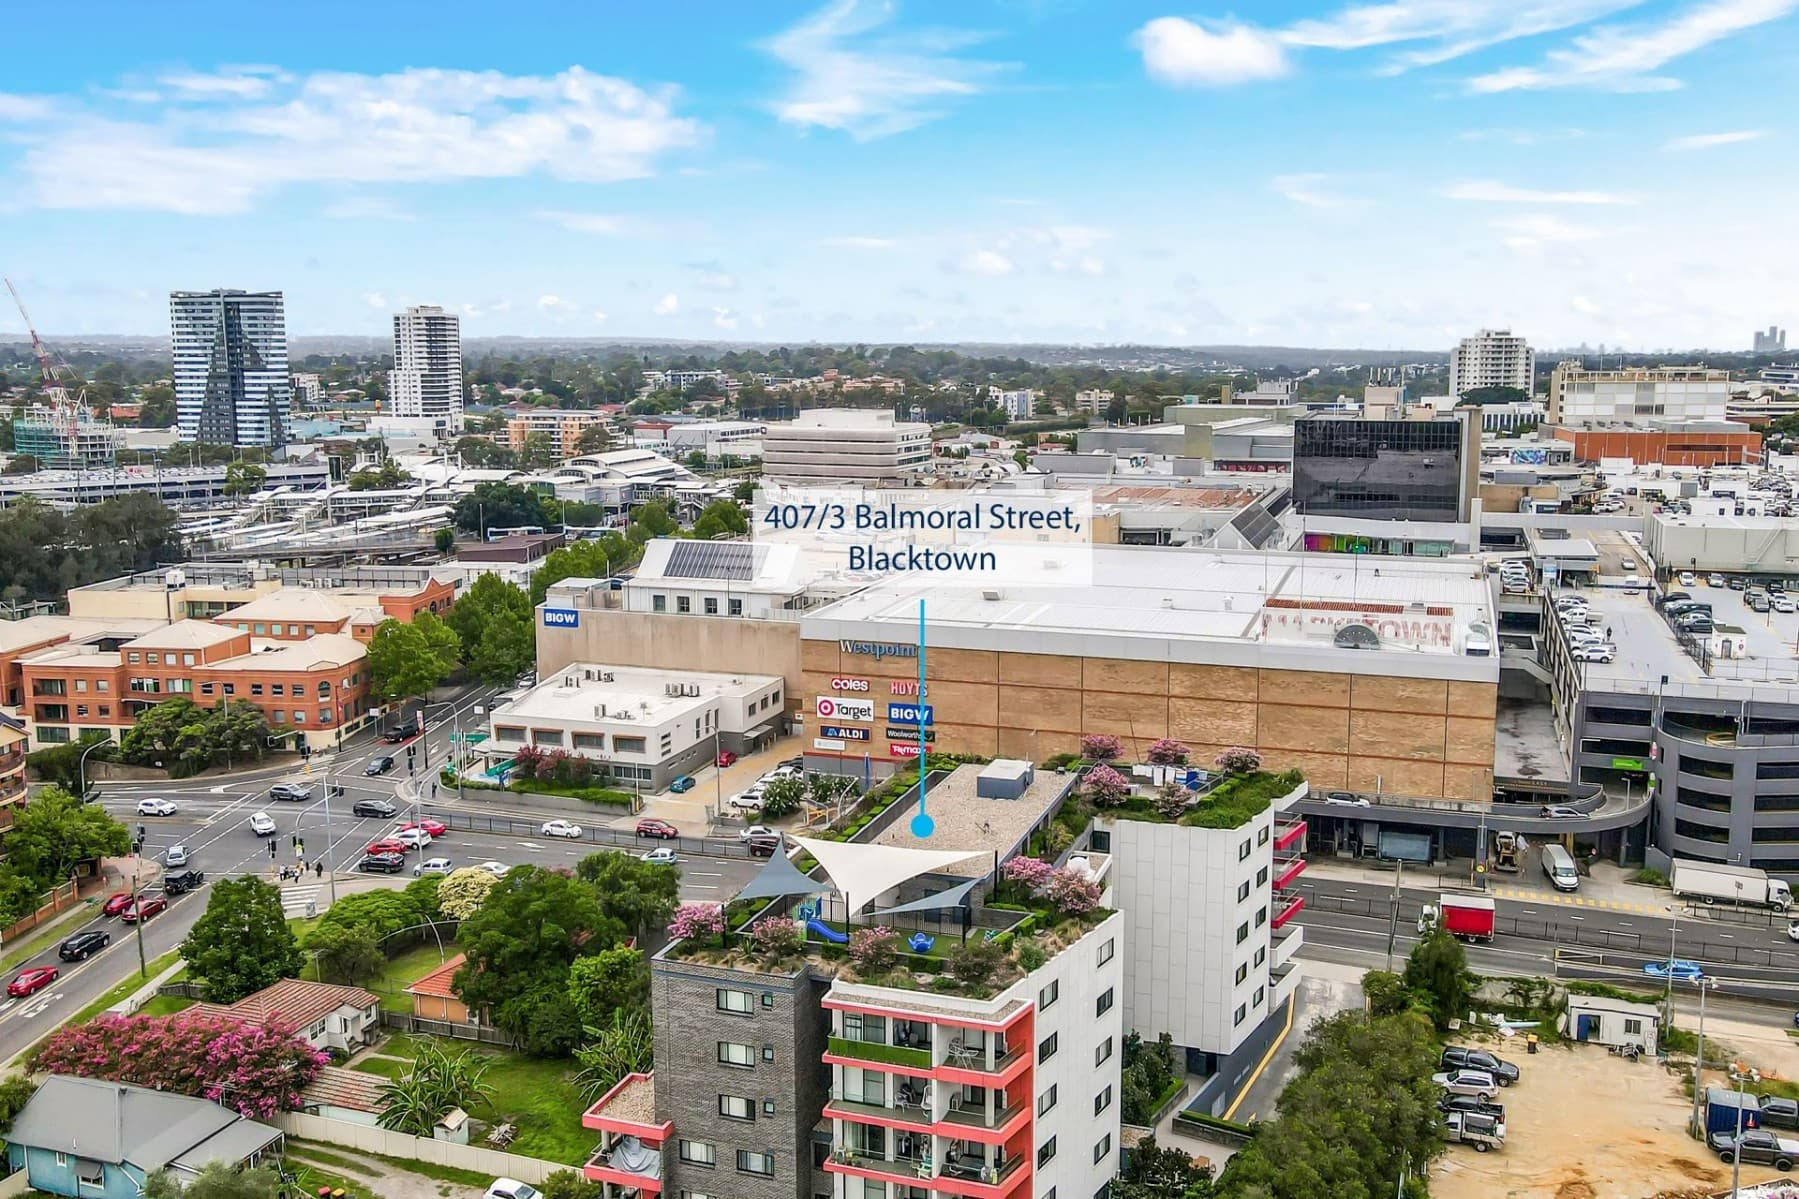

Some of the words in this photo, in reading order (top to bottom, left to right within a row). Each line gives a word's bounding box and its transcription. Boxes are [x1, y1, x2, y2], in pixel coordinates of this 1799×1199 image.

[840, 639, 917, 660] Westpoint
[832, 678, 869, 691] coles
[835, 703, 872, 719] Target
[839, 728, 863, 739] ALDI
